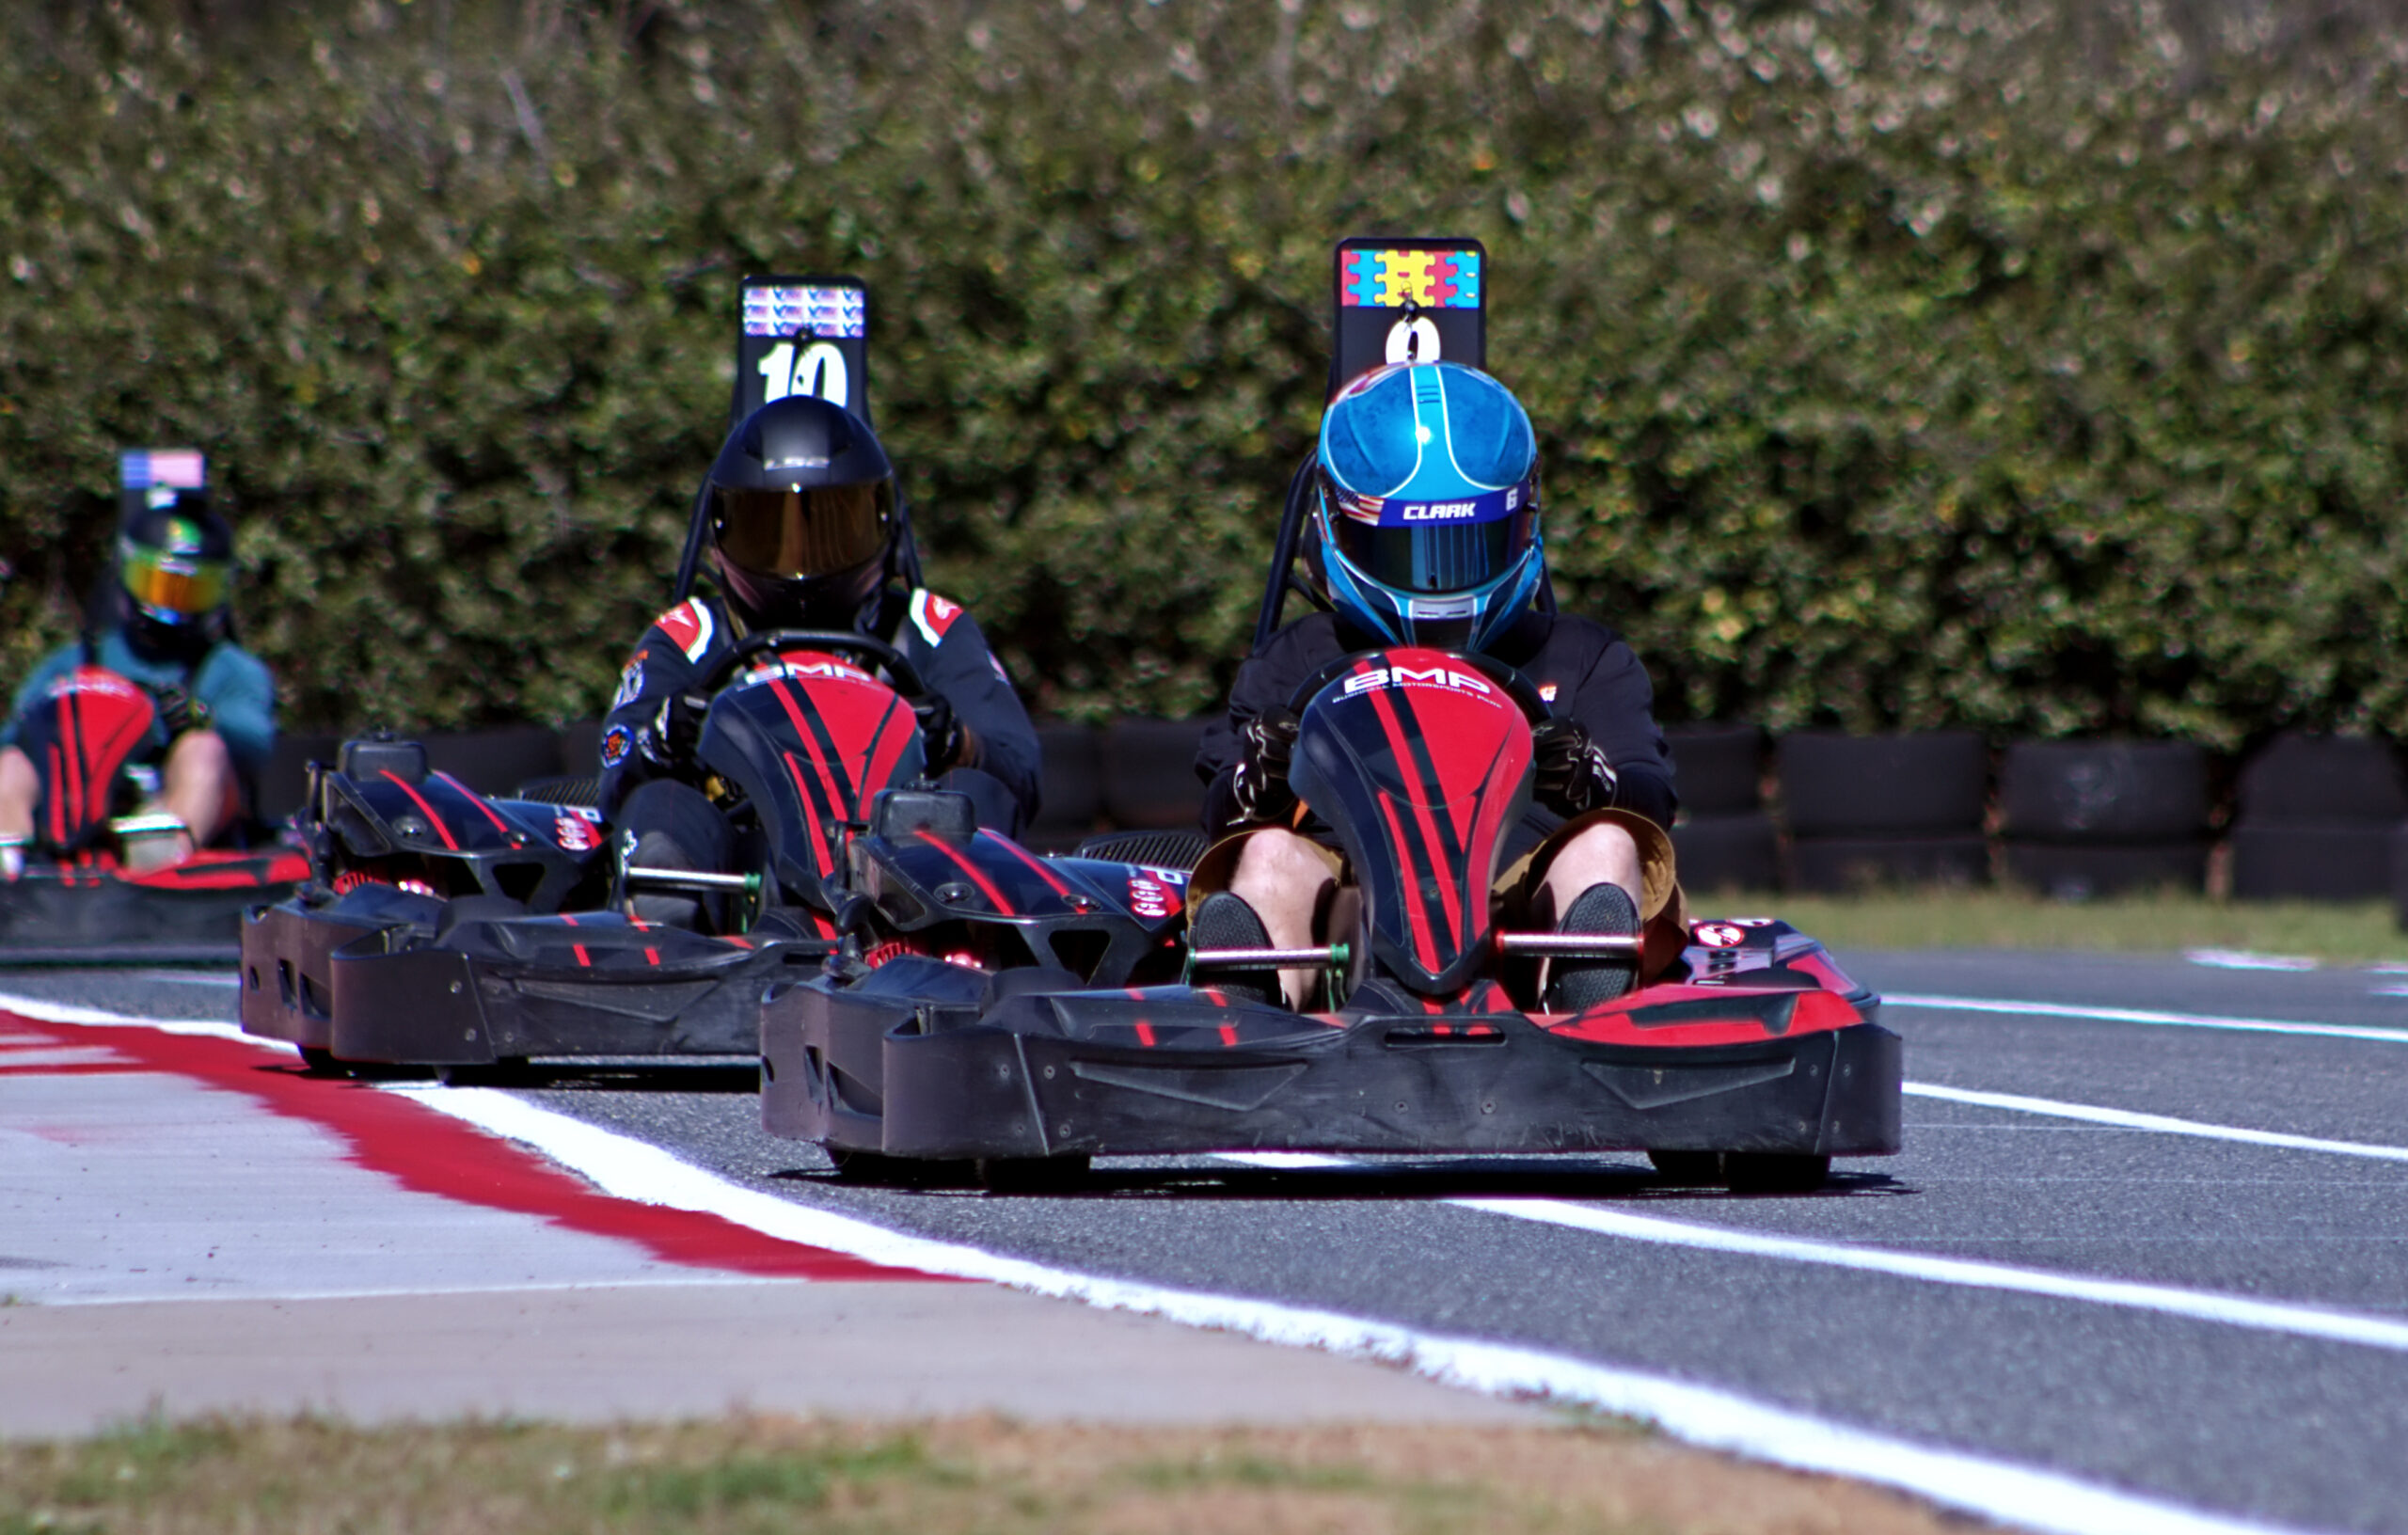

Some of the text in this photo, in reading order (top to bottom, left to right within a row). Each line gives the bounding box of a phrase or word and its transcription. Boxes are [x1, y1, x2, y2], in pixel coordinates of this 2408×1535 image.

[758, 341, 848, 408] 10
[1403, 487, 1518, 520] CLARK 6
[1344, 666, 1491, 694] BMP
